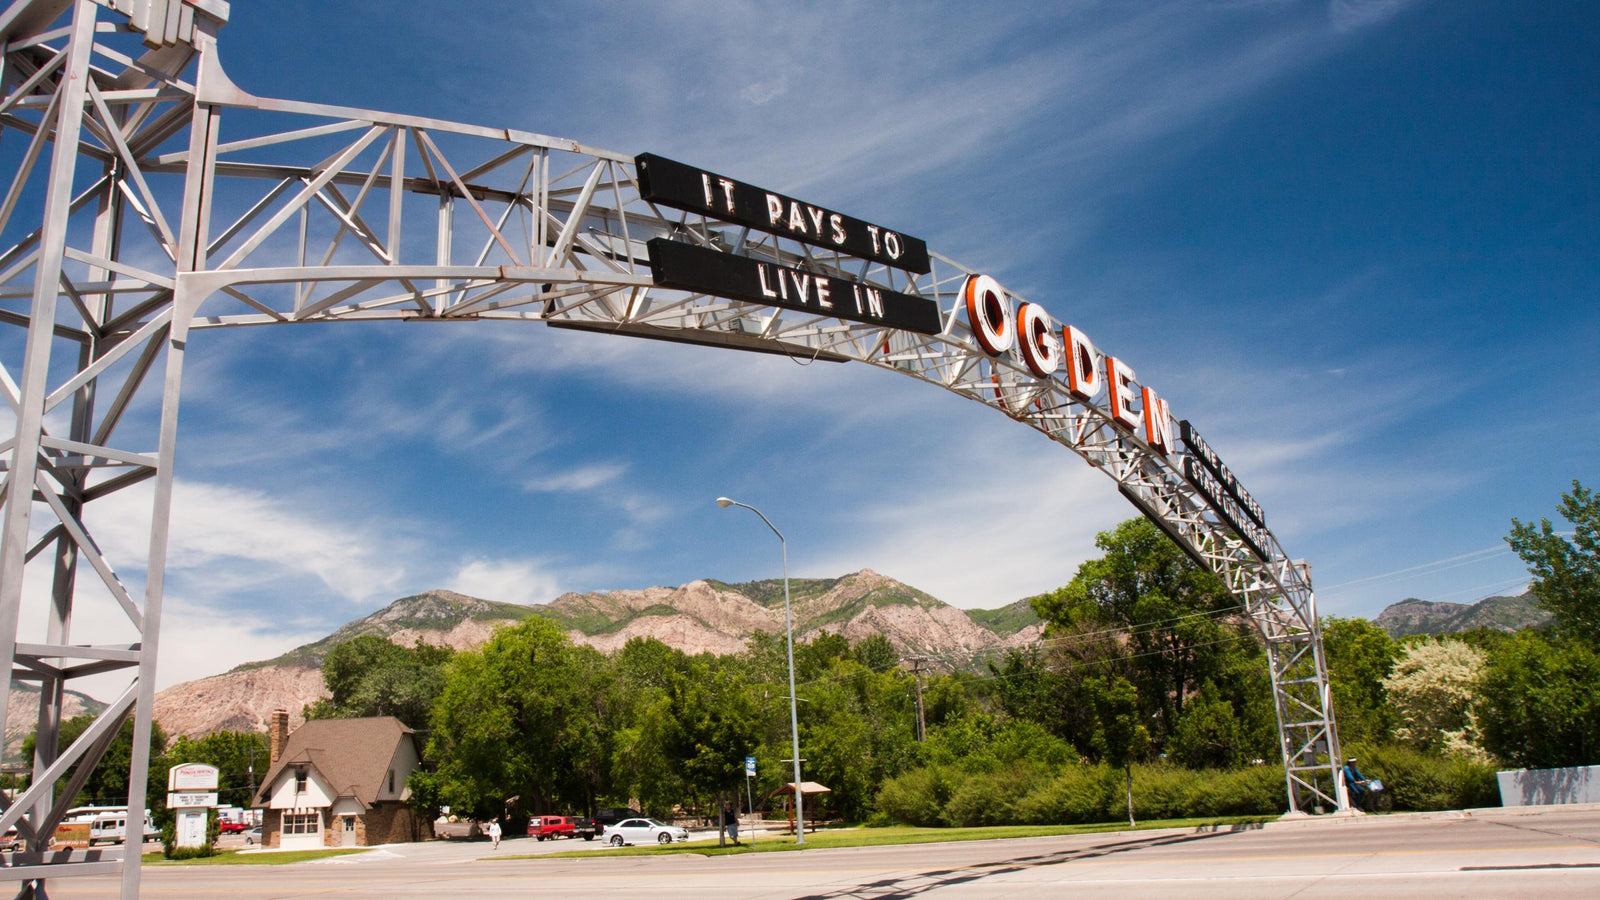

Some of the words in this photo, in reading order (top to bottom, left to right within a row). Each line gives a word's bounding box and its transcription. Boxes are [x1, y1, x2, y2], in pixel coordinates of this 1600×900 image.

[701, 173, 735, 214] IT
[765, 193, 847, 244] PAYS
[867, 225, 905, 260] TO
[758, 263, 834, 309] LIVE
[853, 284, 885, 318] IN
[966, 274, 1175, 455] OGDEN
[1190, 426, 1218, 469] HOME
[1220, 463, 1234, 486] OF
[1191, 461, 1223, 507] STATE
